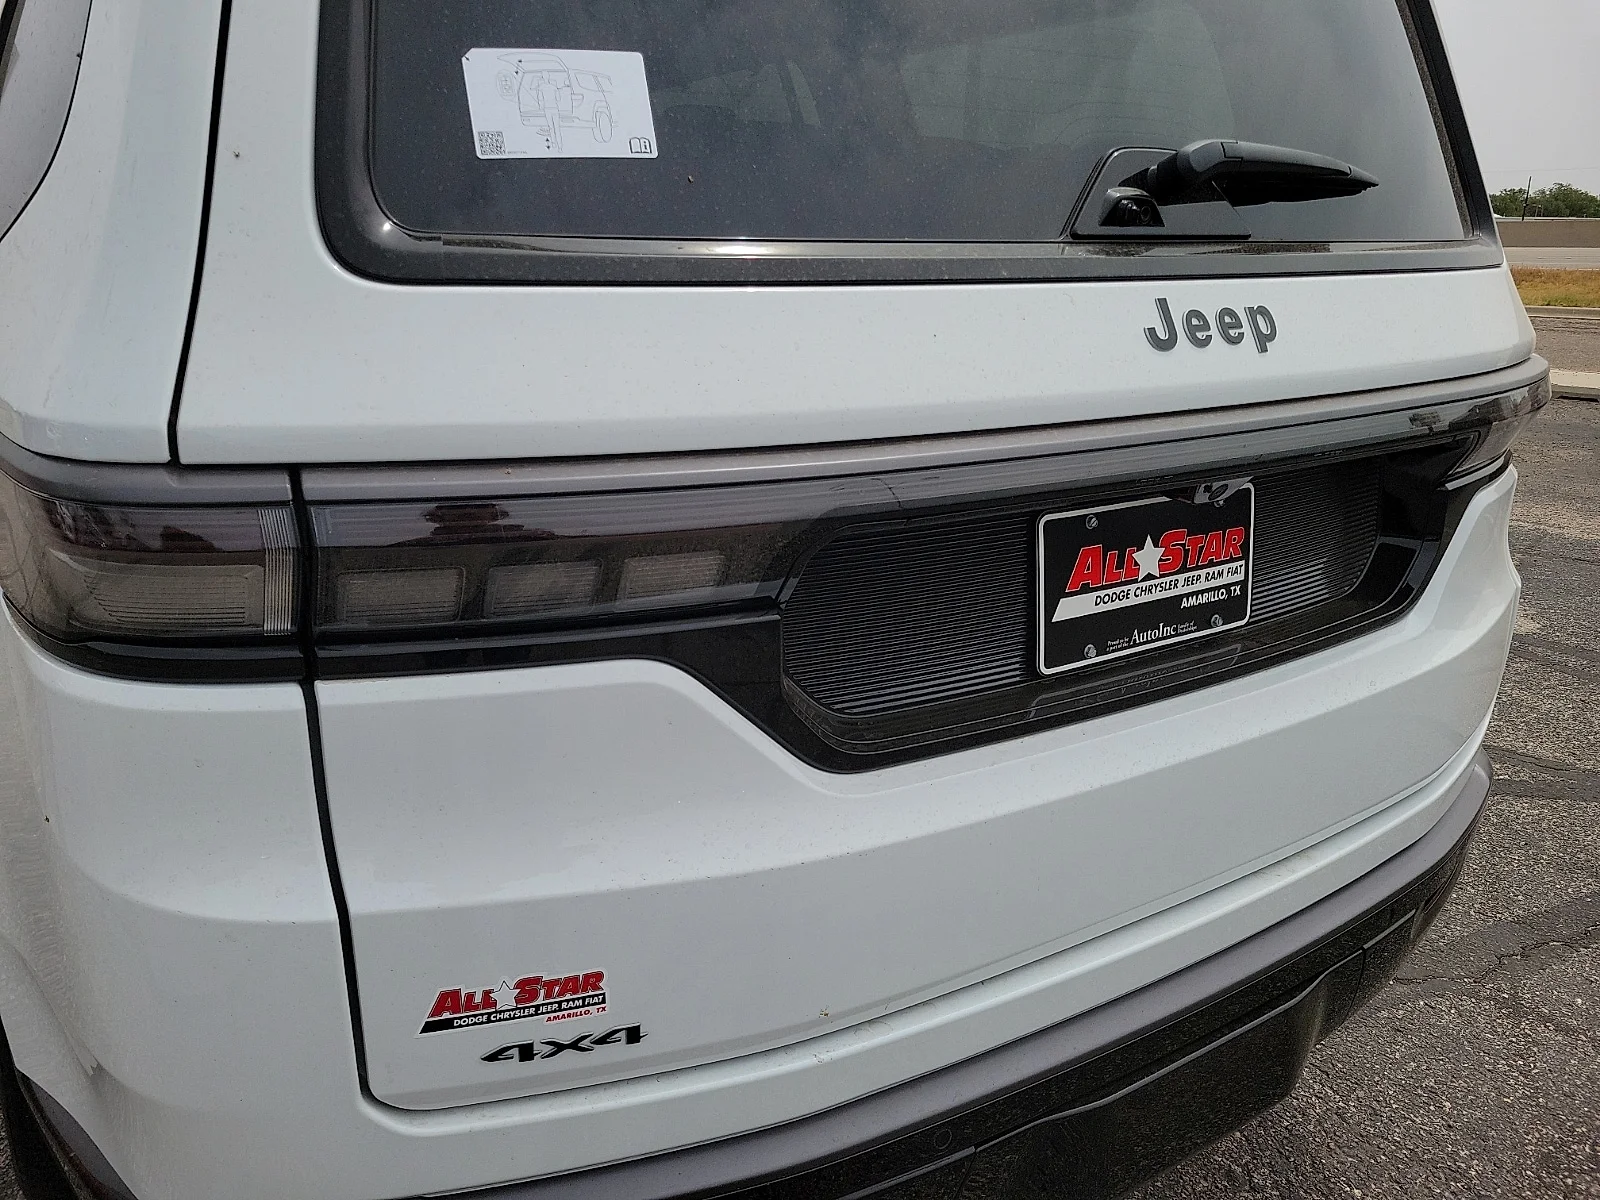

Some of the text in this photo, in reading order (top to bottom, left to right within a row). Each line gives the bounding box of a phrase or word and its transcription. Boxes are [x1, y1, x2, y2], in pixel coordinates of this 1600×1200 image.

[1143, 297, 1277, 353] Jeep
[1158, 527, 1245, 574] STAR
[1094, 589, 1131, 606] DODGE
[1133, 578, 1180, 598] CHRYSLER
[1204, 568, 1225, 583] RAM
[1226, 563, 1244, 578] FIAT
[1180, 584, 1242, 609] AMARILLO, TX
[1129, 622, 1177, 645] AutoInc
[513, 970, 605, 1008] STAR
[453, 1014, 488, 1027] DODGE
[490, 1007, 536, 1021] CHRYSLER
[561, 998, 583, 1009] RAM
[584, 995, 604, 1006] FIAT
[545, 1005, 607, 1023] AMARILLO, TX
